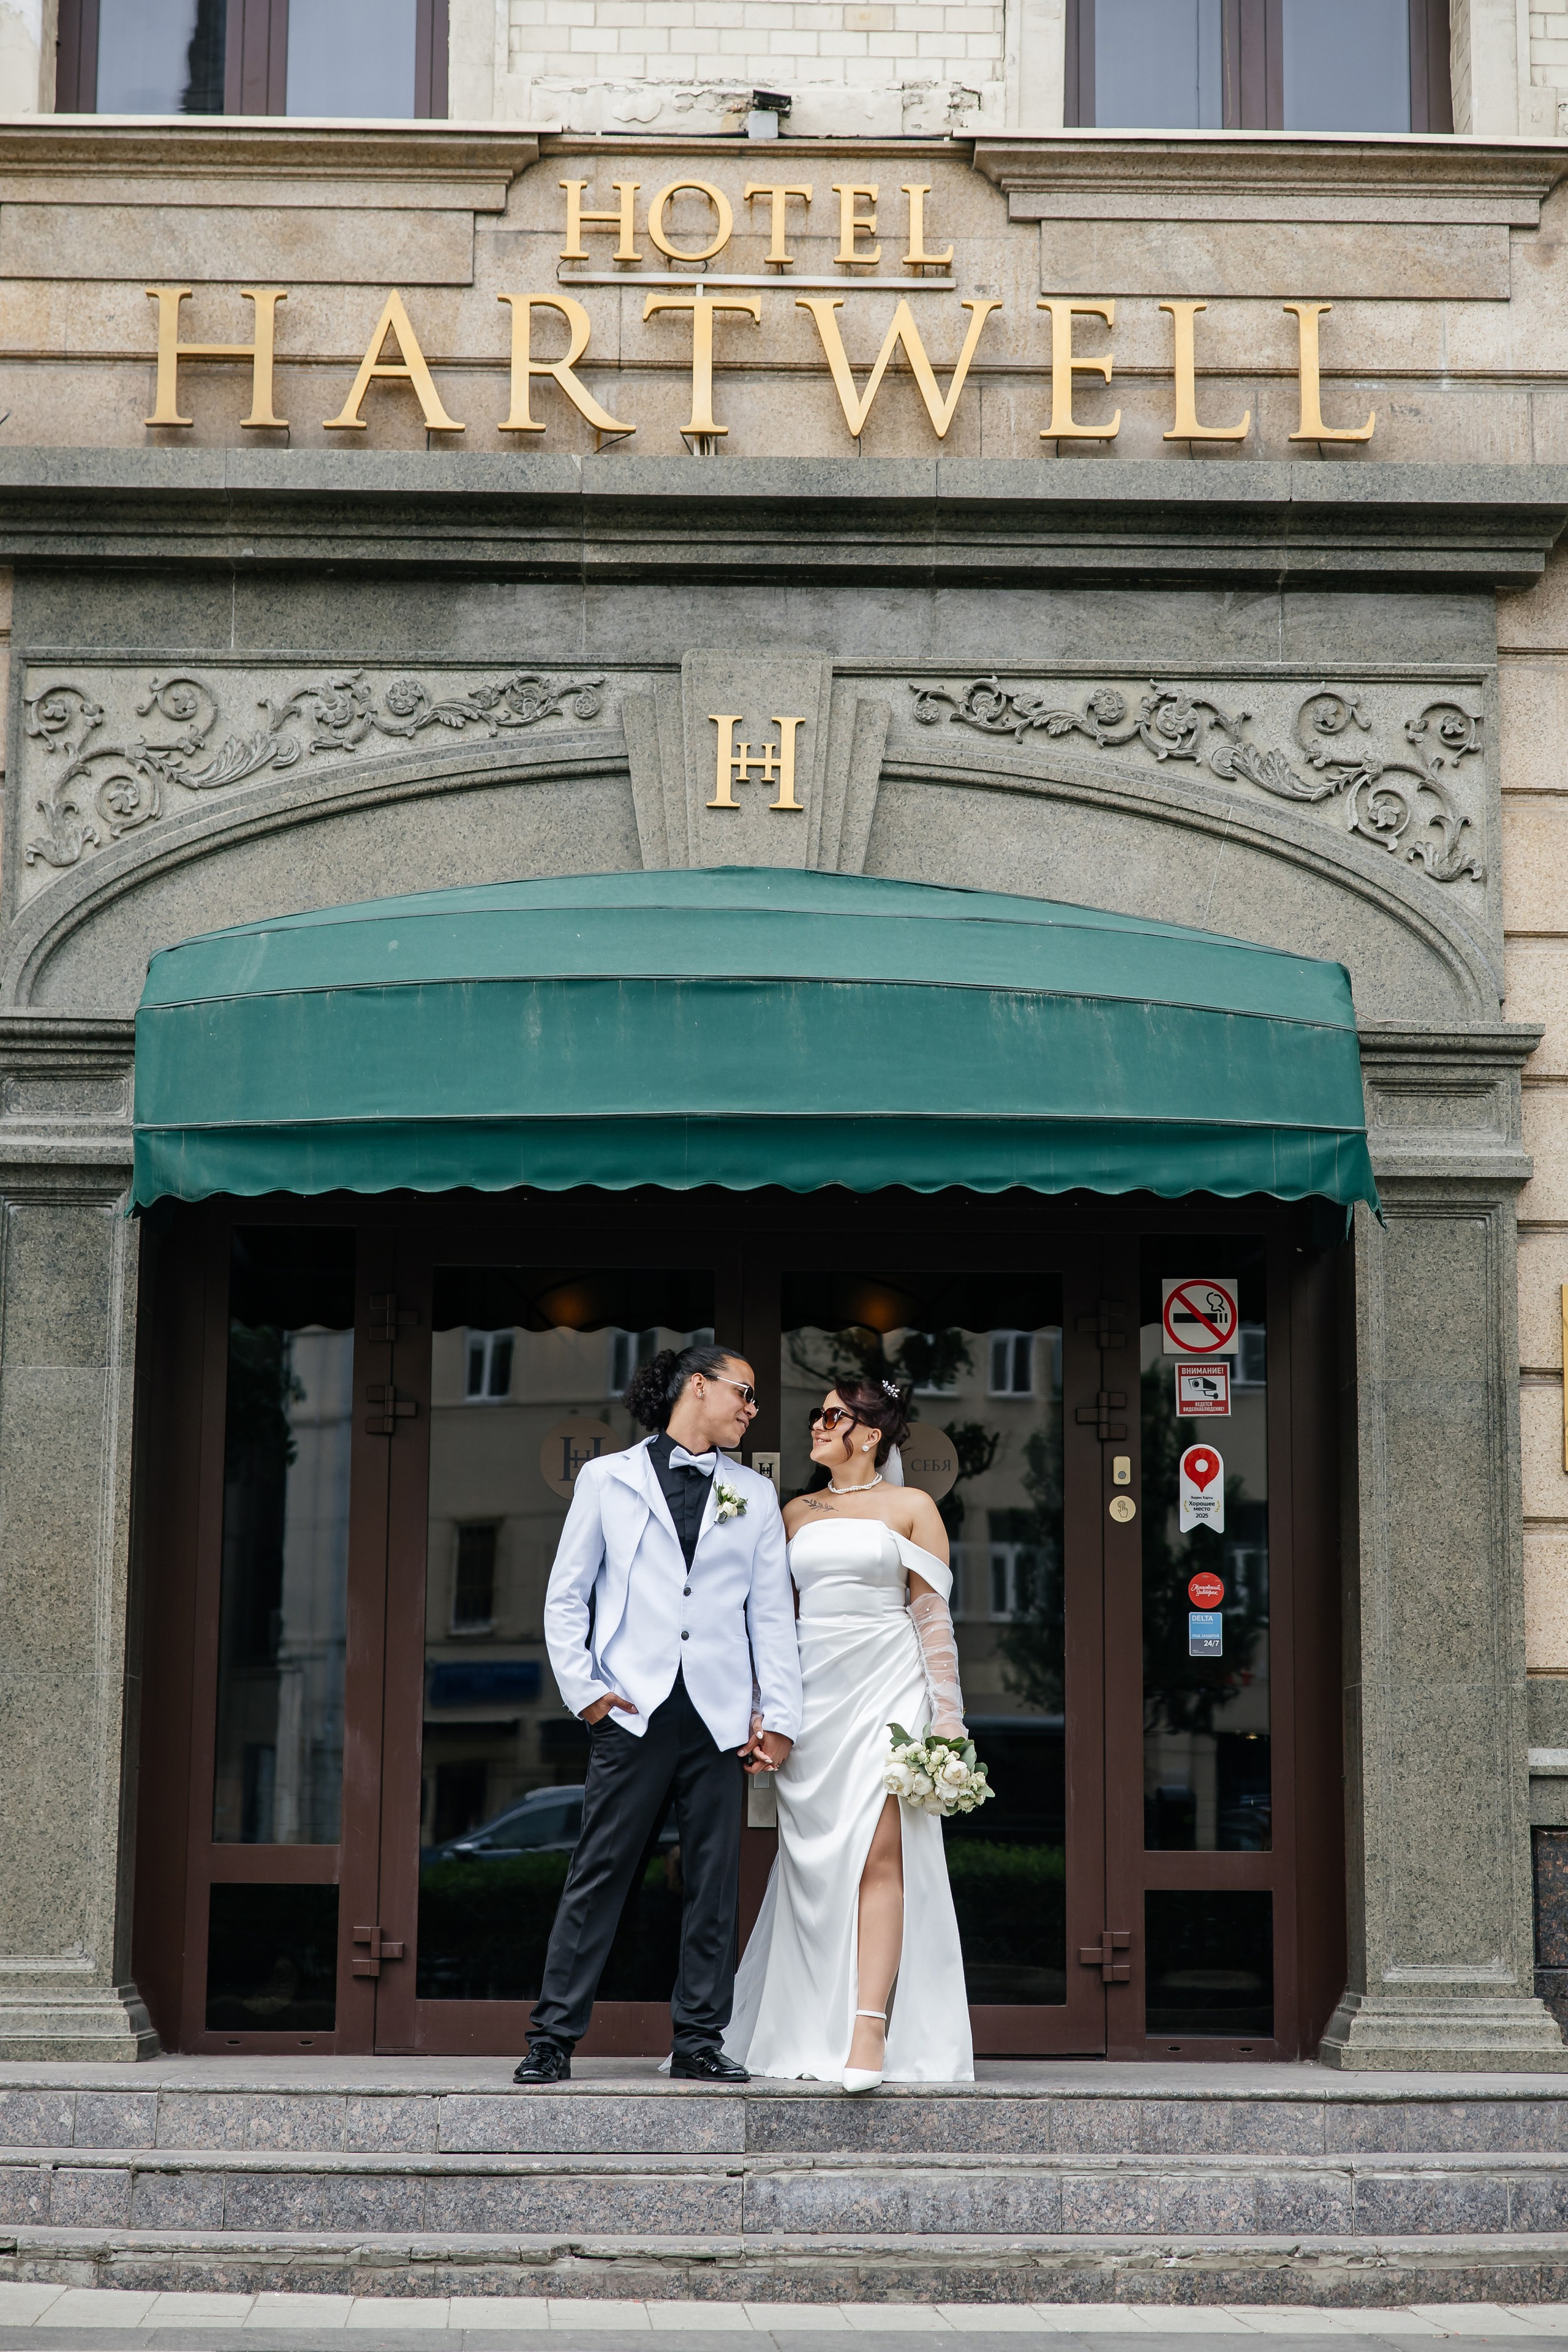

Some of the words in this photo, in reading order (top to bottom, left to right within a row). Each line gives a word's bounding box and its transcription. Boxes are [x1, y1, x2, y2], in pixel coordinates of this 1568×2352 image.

[559, 179, 954, 267] HOTEL
[145, 288, 1376, 444] HARTWELL
[911, 1459, 951, 1472] СЕБЯ
